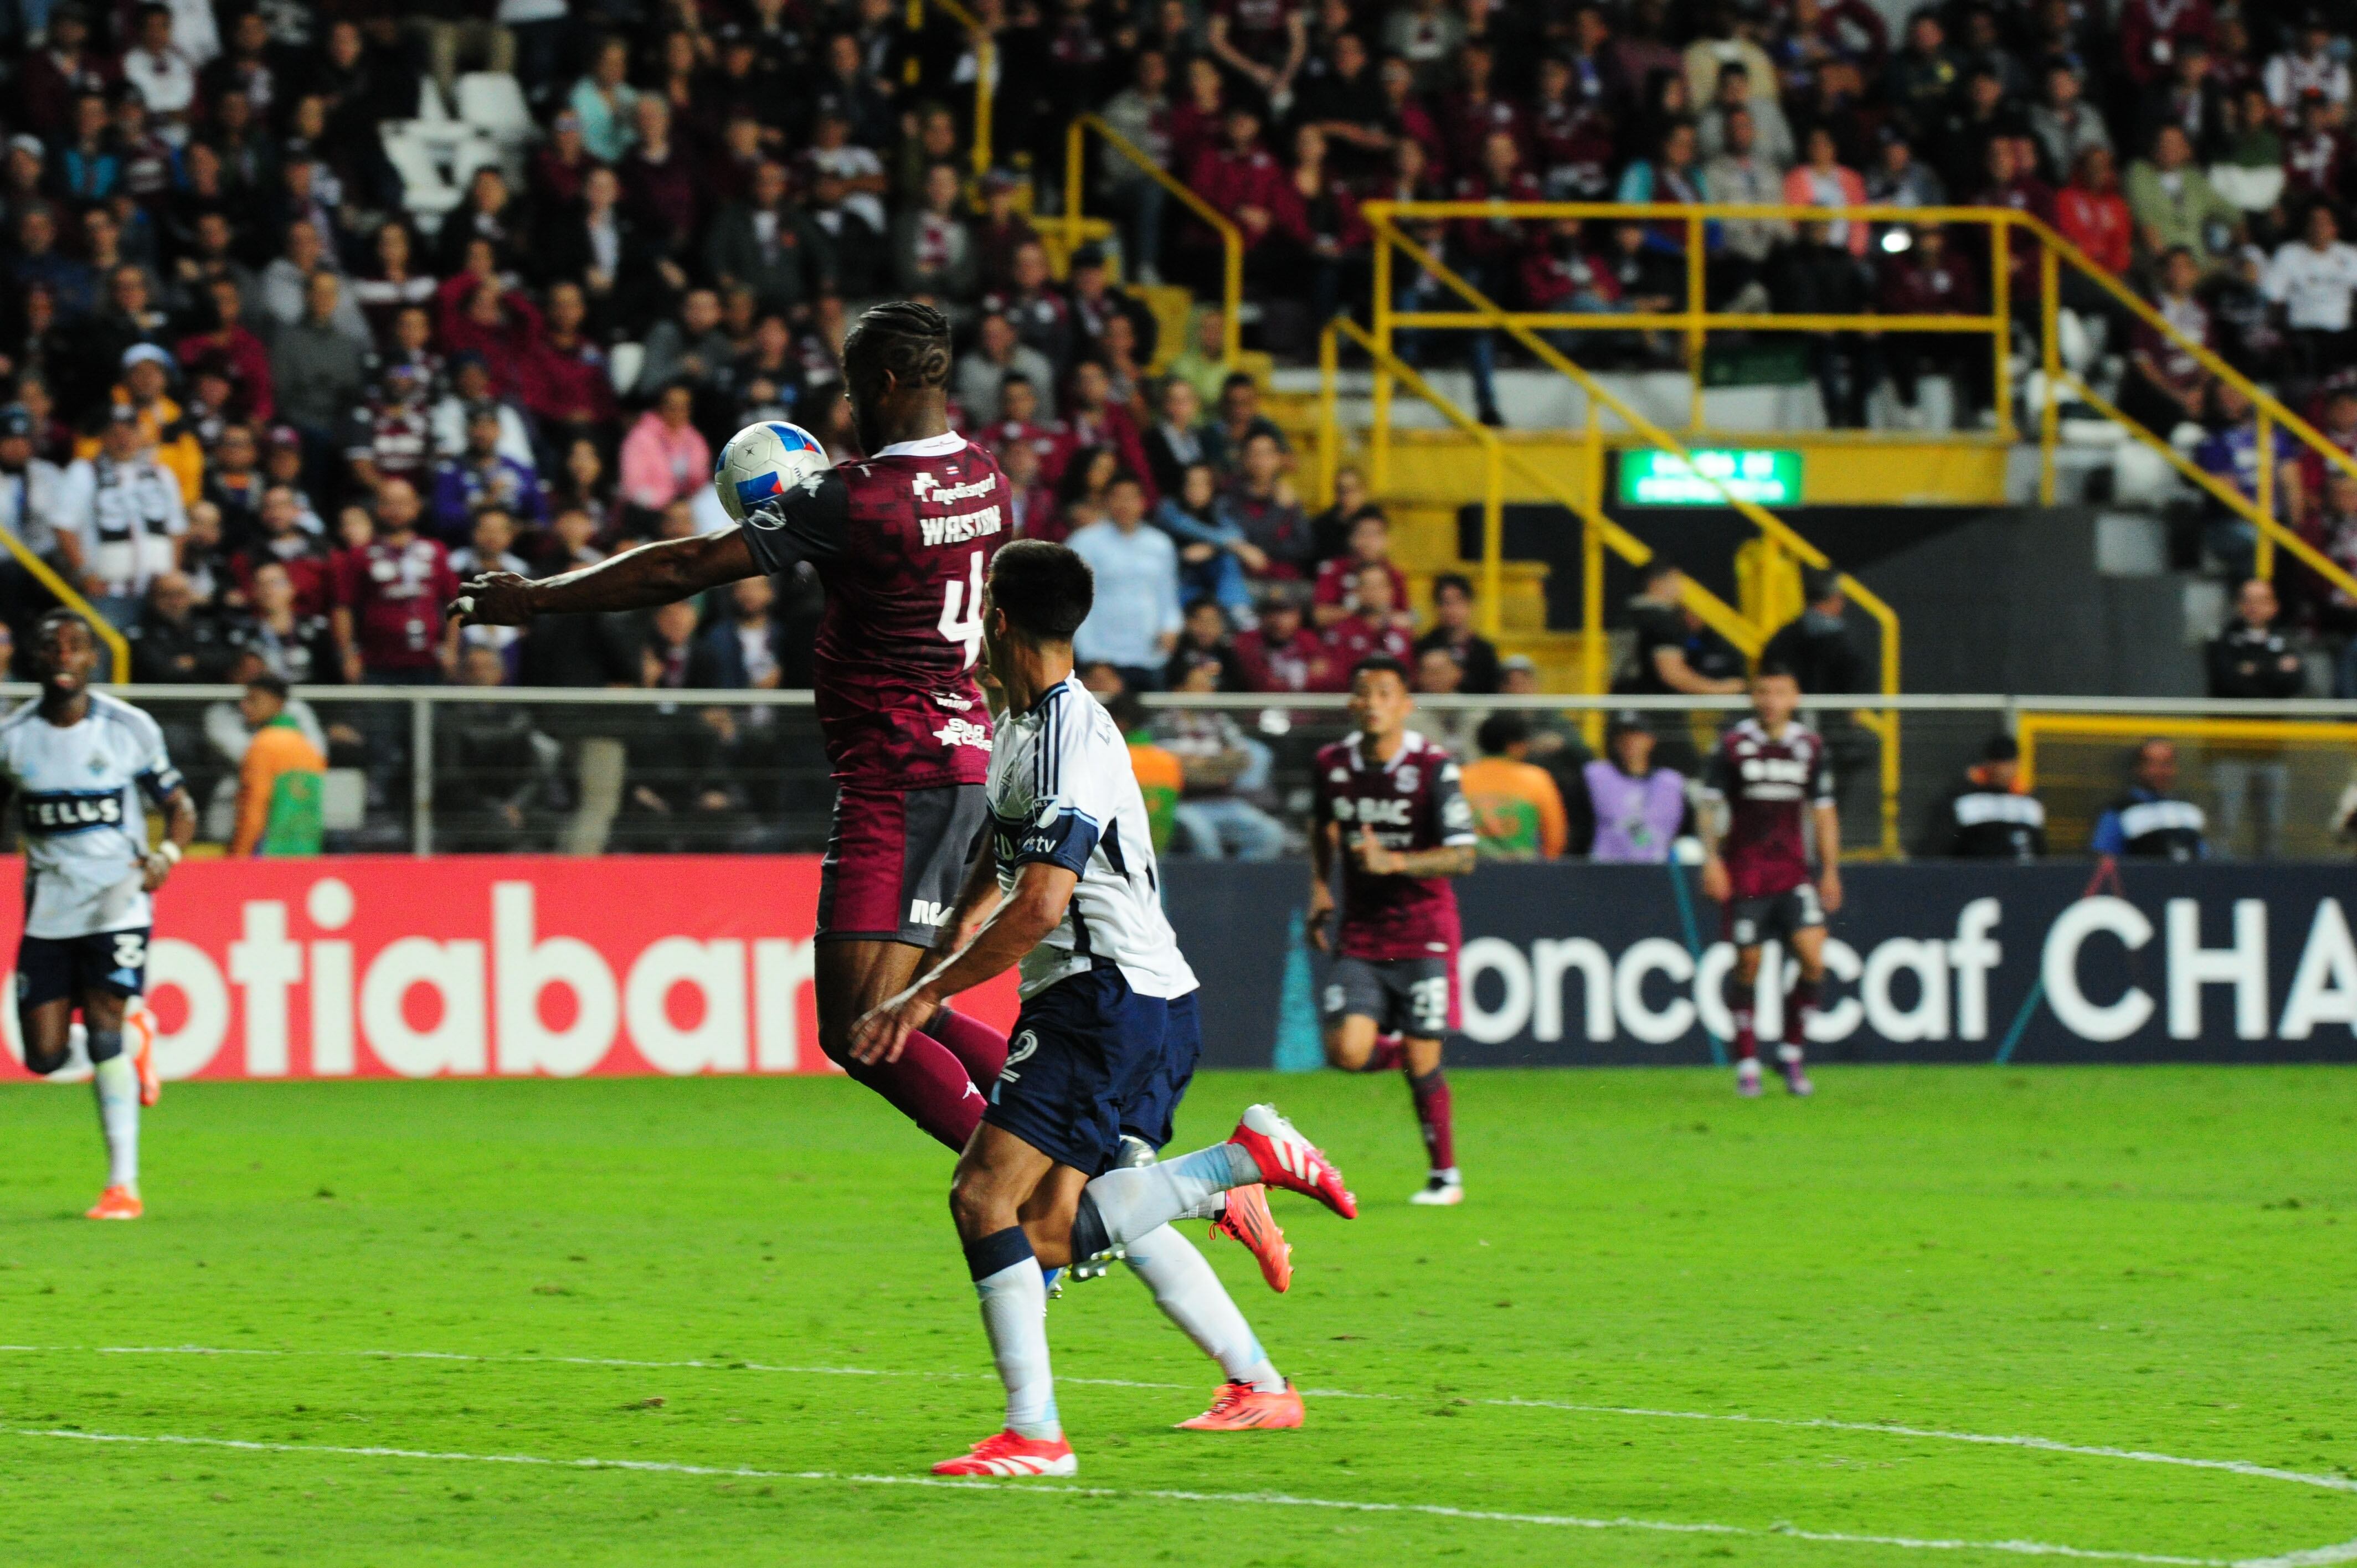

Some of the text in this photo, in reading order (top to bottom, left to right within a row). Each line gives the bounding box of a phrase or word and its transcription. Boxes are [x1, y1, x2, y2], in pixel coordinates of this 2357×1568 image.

[937, 551, 984, 670] 4
[1036, 835, 1057, 853] tv
[1458, 895, 2357, 1044] oncacaf CHA
[999, 1029, 1038, 1083] 2
